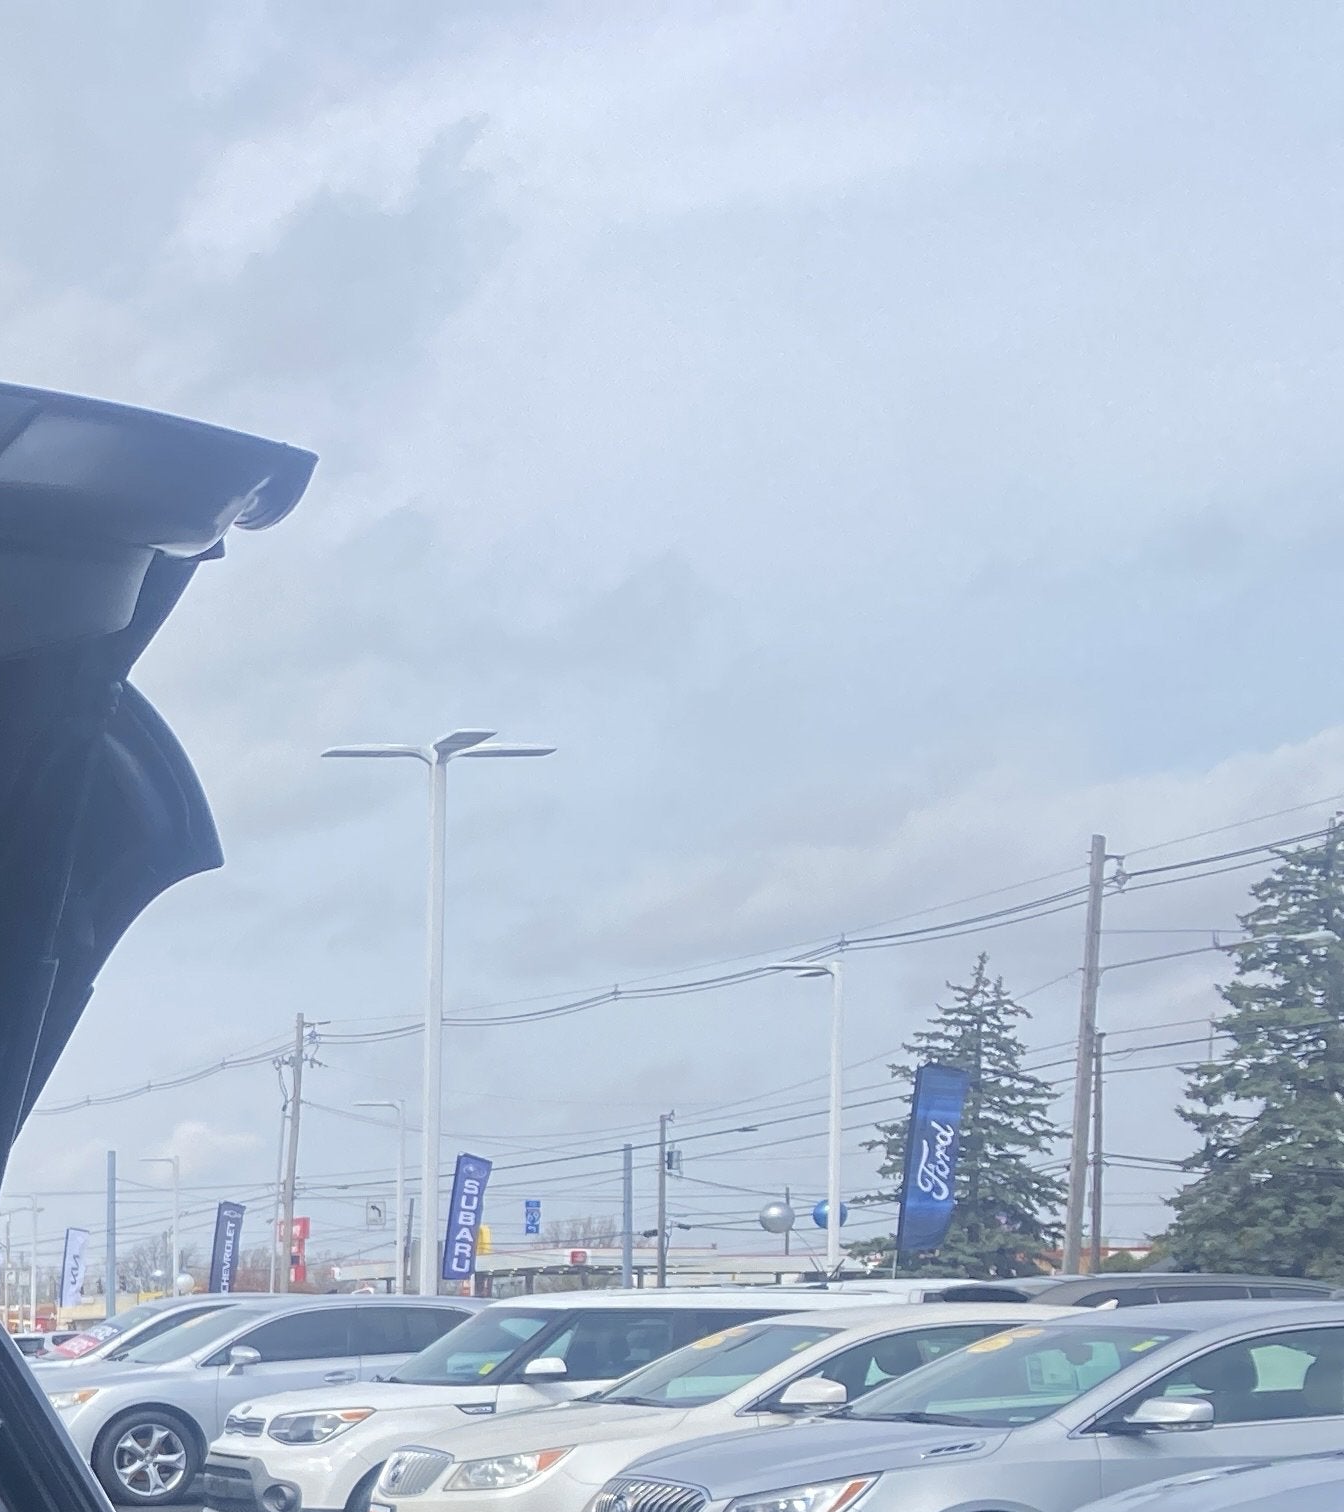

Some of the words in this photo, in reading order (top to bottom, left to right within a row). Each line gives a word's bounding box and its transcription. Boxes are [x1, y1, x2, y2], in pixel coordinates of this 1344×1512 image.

[918, 1120, 954, 1200] Ford
[221, 1221, 236, 1296] CHEVROLET
[452, 1179, 480, 1273] SUBARU
